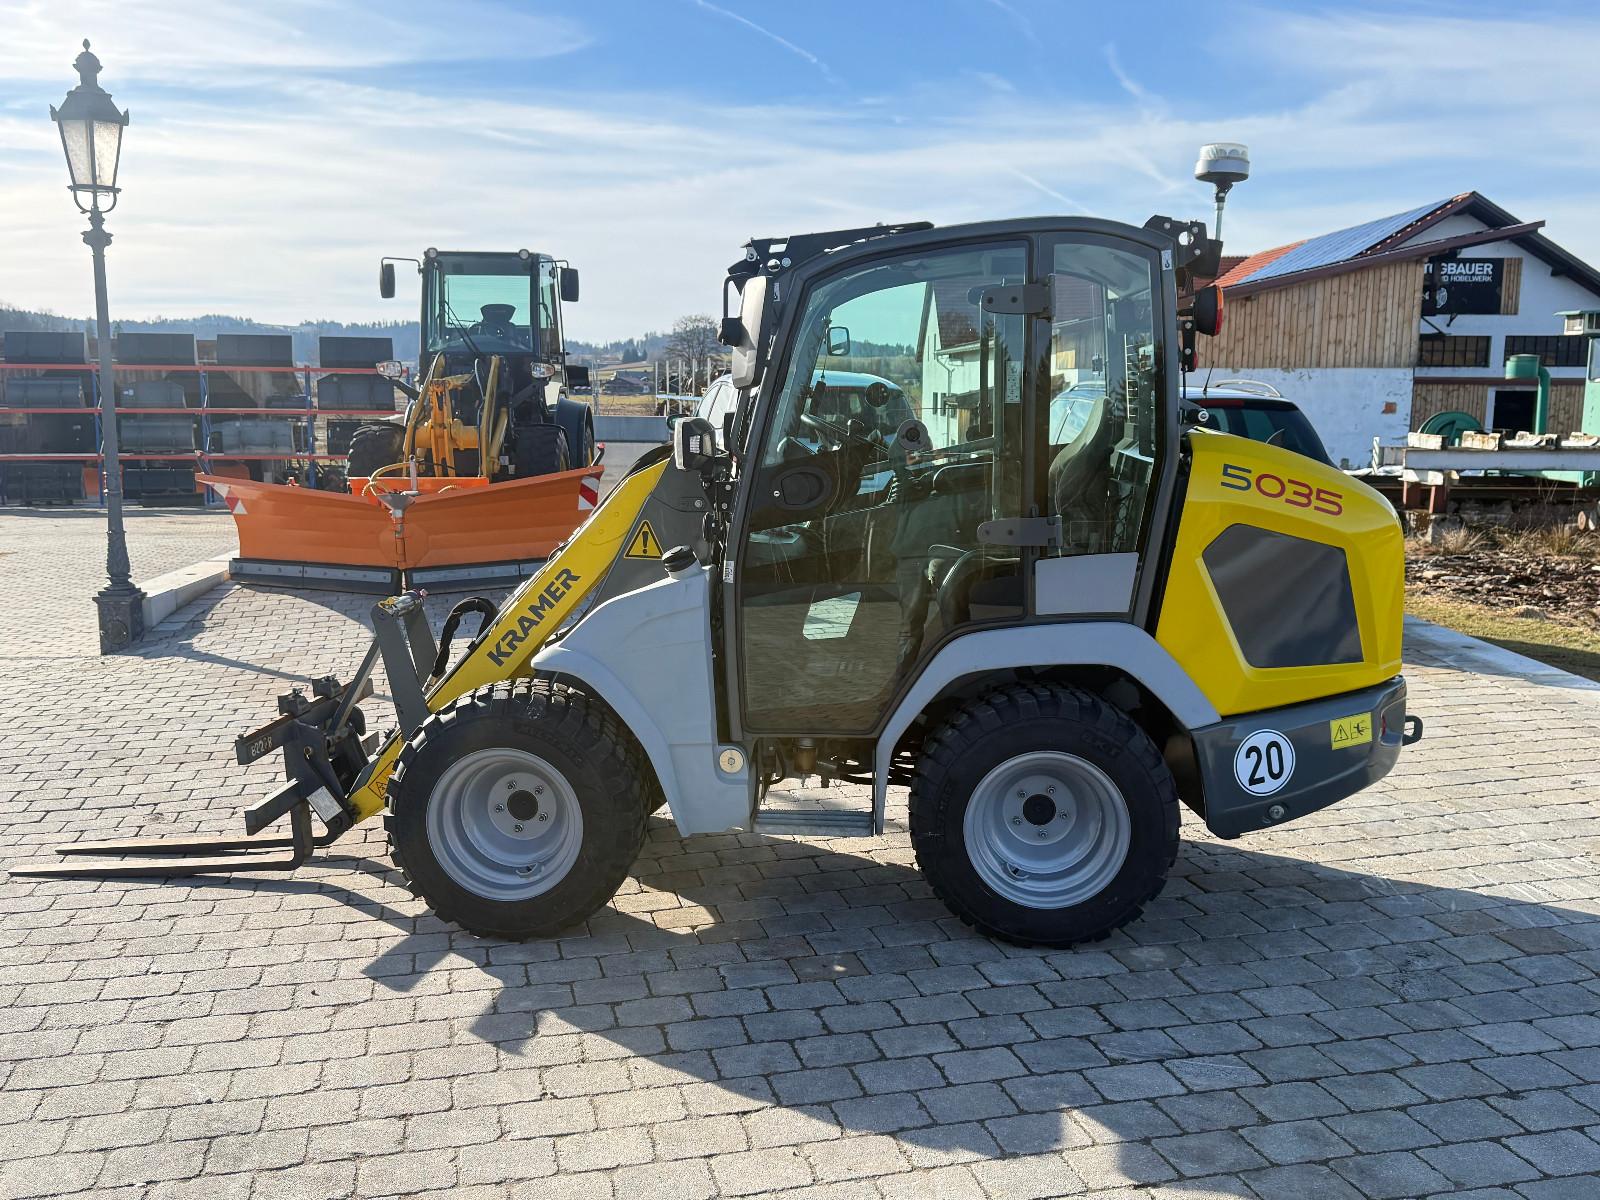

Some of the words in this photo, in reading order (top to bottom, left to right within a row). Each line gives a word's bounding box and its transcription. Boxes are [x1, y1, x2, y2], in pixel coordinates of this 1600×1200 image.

[1221, 464, 1343, 516] 5035
[486, 568, 581, 667] KRAMER
[1246, 740, 1284, 786] 20
